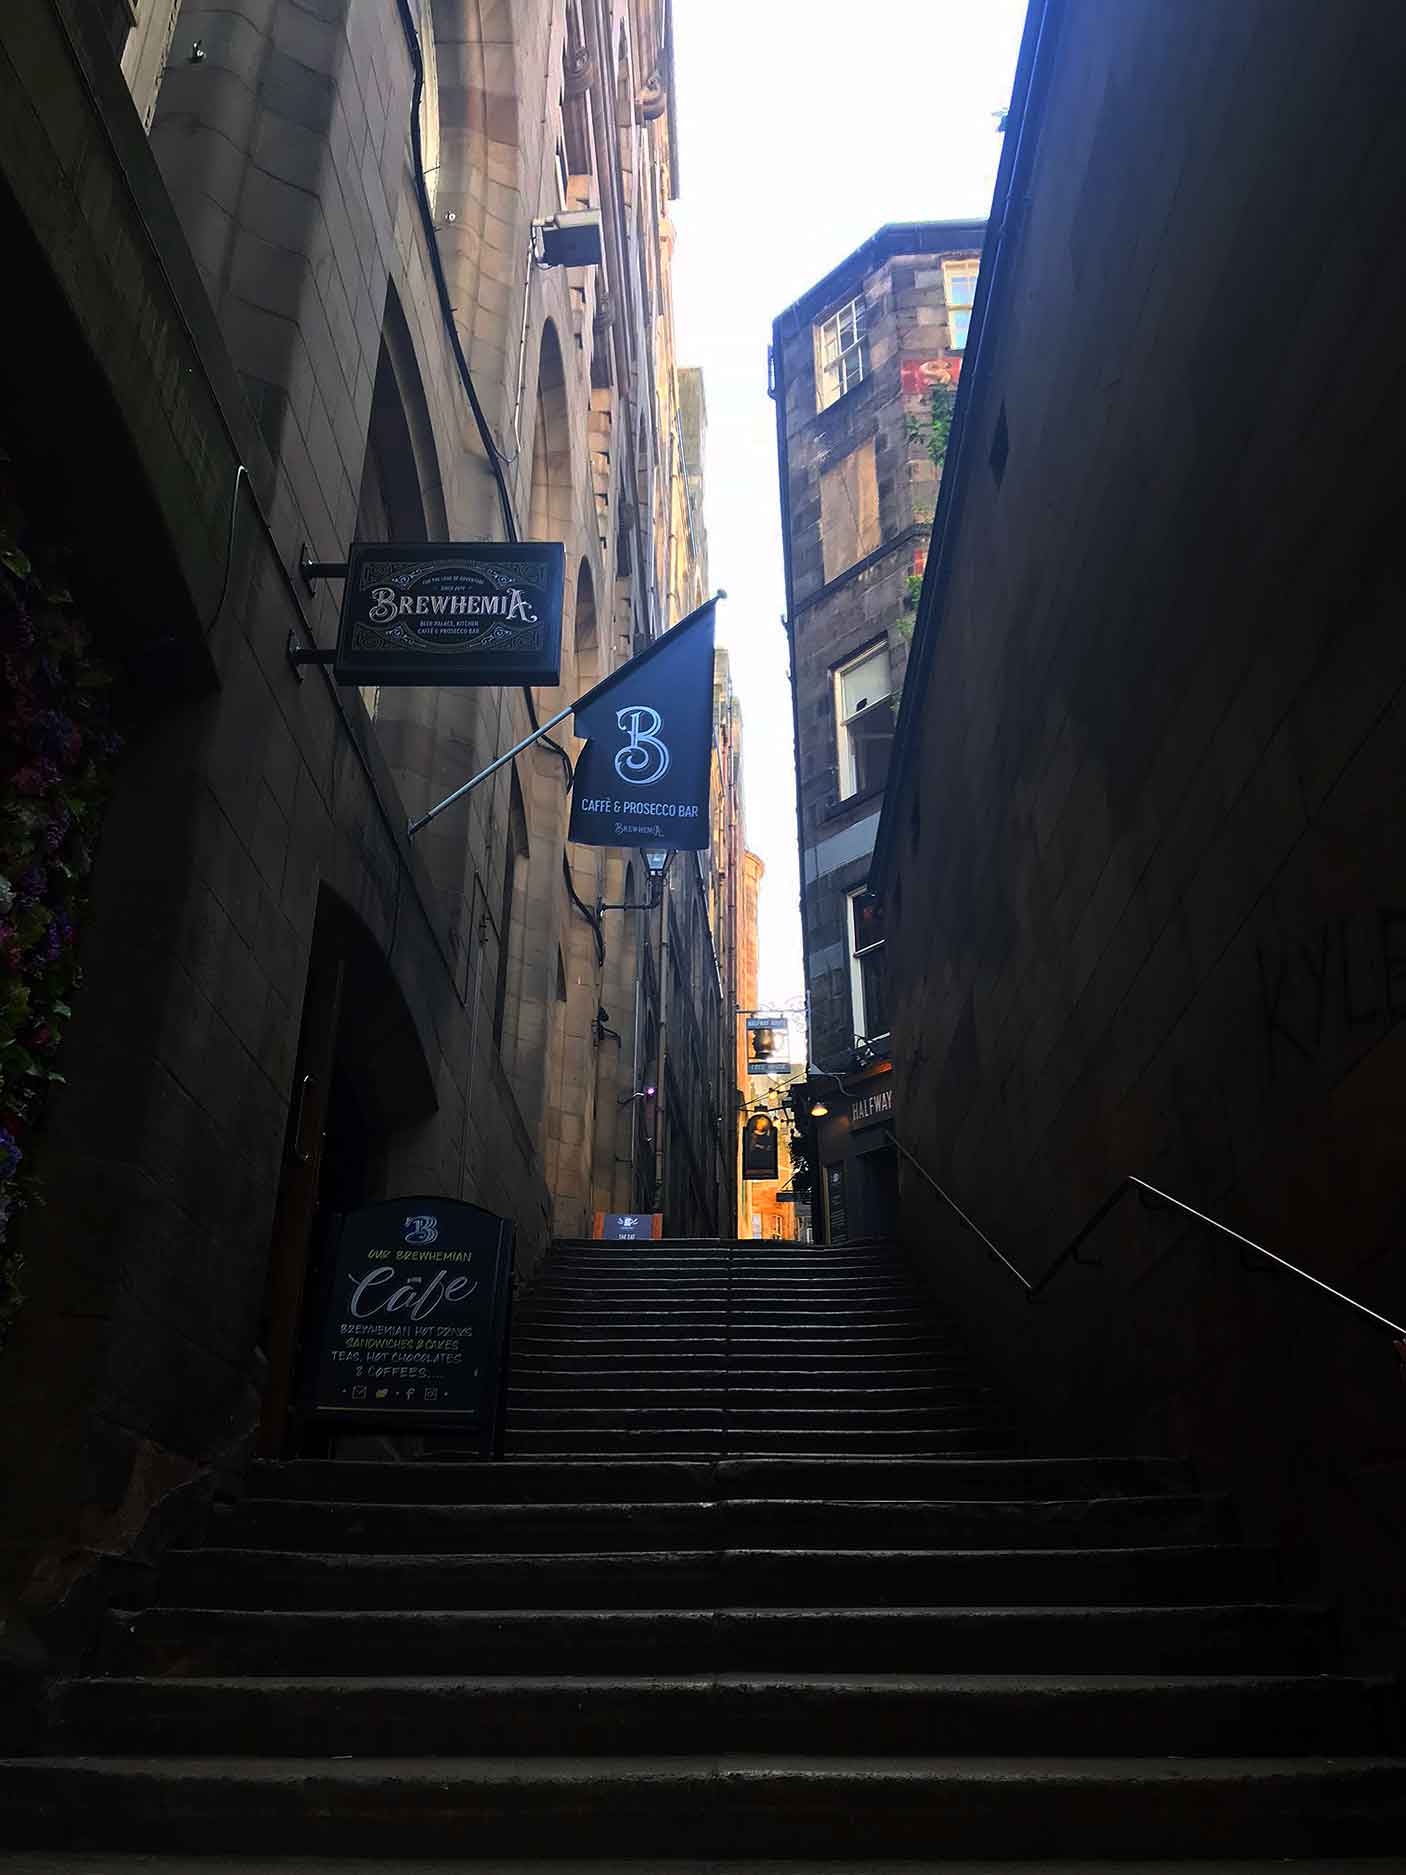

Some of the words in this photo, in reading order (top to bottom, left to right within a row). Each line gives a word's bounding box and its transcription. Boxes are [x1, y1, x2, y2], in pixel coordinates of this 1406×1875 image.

[369, 587, 538, 623] BREWHEMIA
[613, 801, 621, 813] &
[623, 801, 676, 816] PROSECCO
[678, 805, 698, 817] BAR
[852, 1090, 893, 1120] HALFWAY
[396, 1251, 472, 1262] BREWHEMIAN
